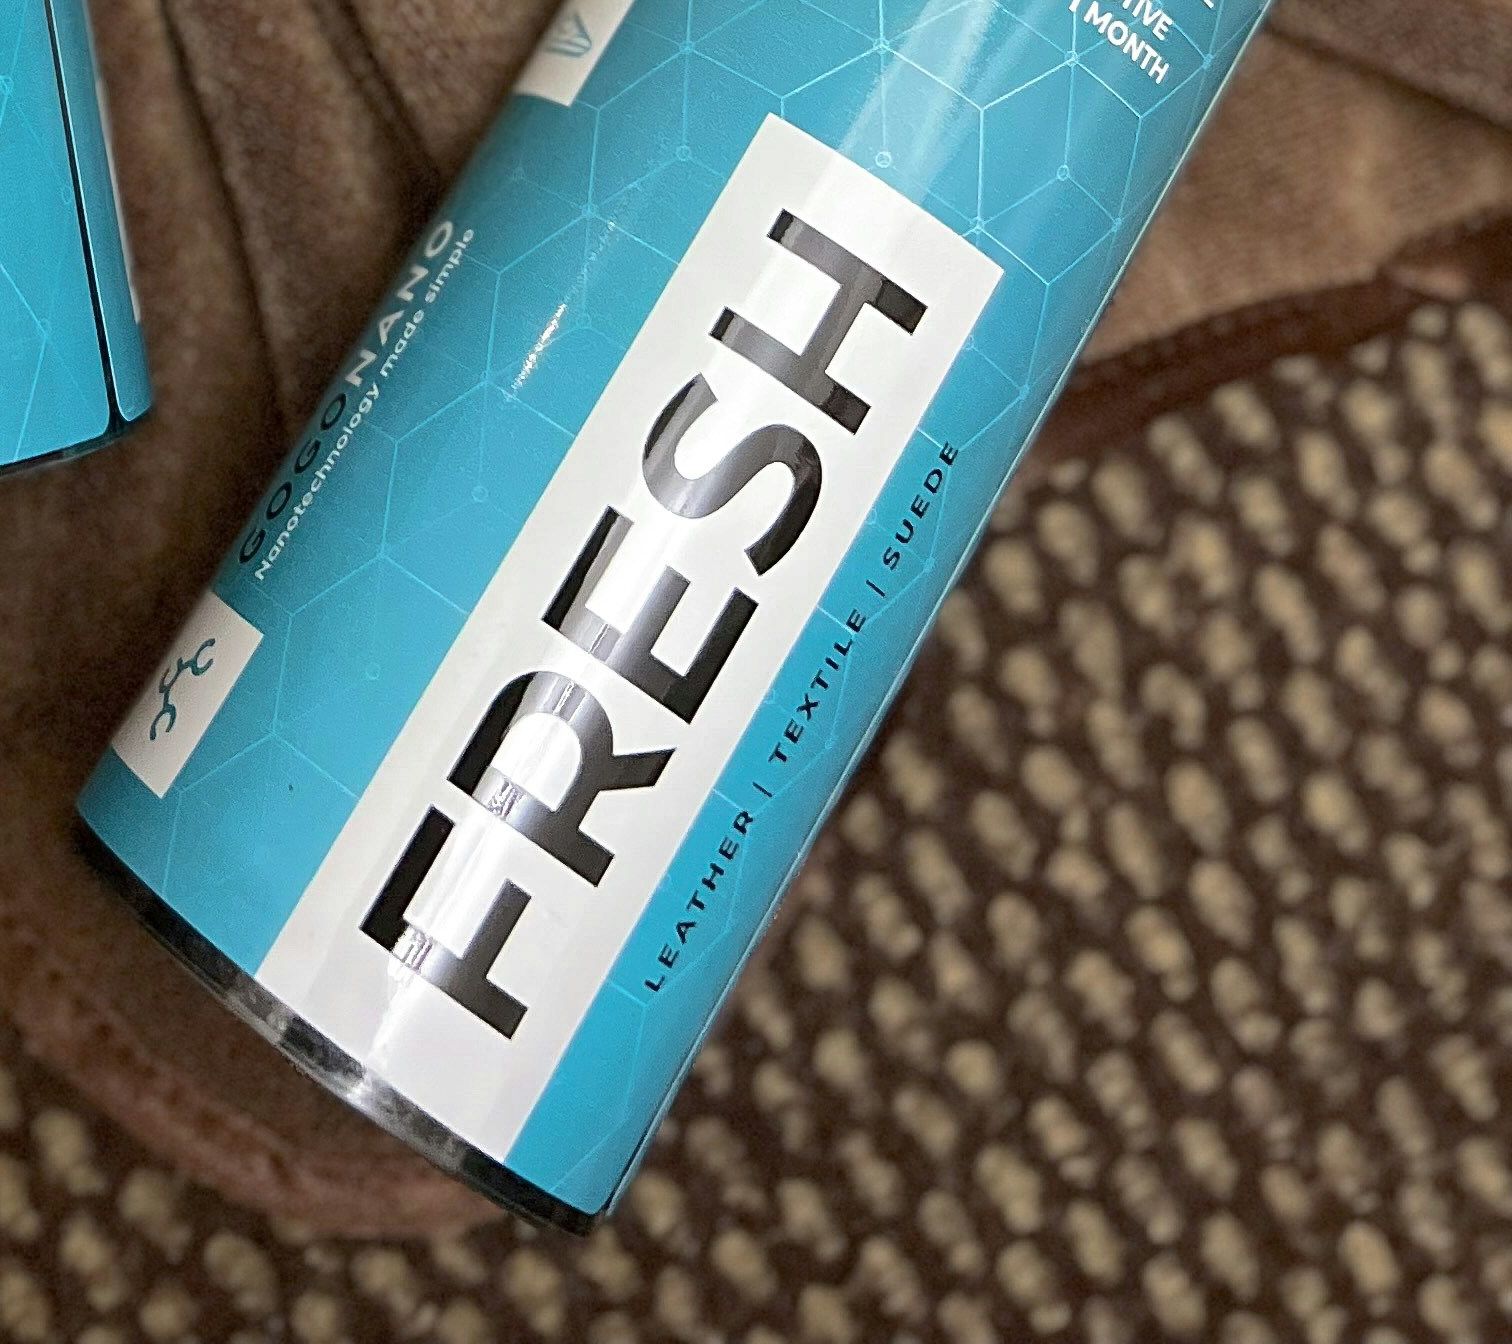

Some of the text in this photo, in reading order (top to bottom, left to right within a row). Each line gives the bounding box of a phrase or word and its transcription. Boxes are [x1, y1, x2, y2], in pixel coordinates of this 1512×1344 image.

[1083, 1, 1170, 85] MONTH
[239, 220, 453, 565] GOGONANO
[254, 228, 474, 581] Nanotechnology made simple
[360, 207, 929, 1041] FRESH
[643, 810, 754, 993] LEATHER
[768, 608, 867, 766] TEXTILE
[882, 441, 959, 571] SUEDE
